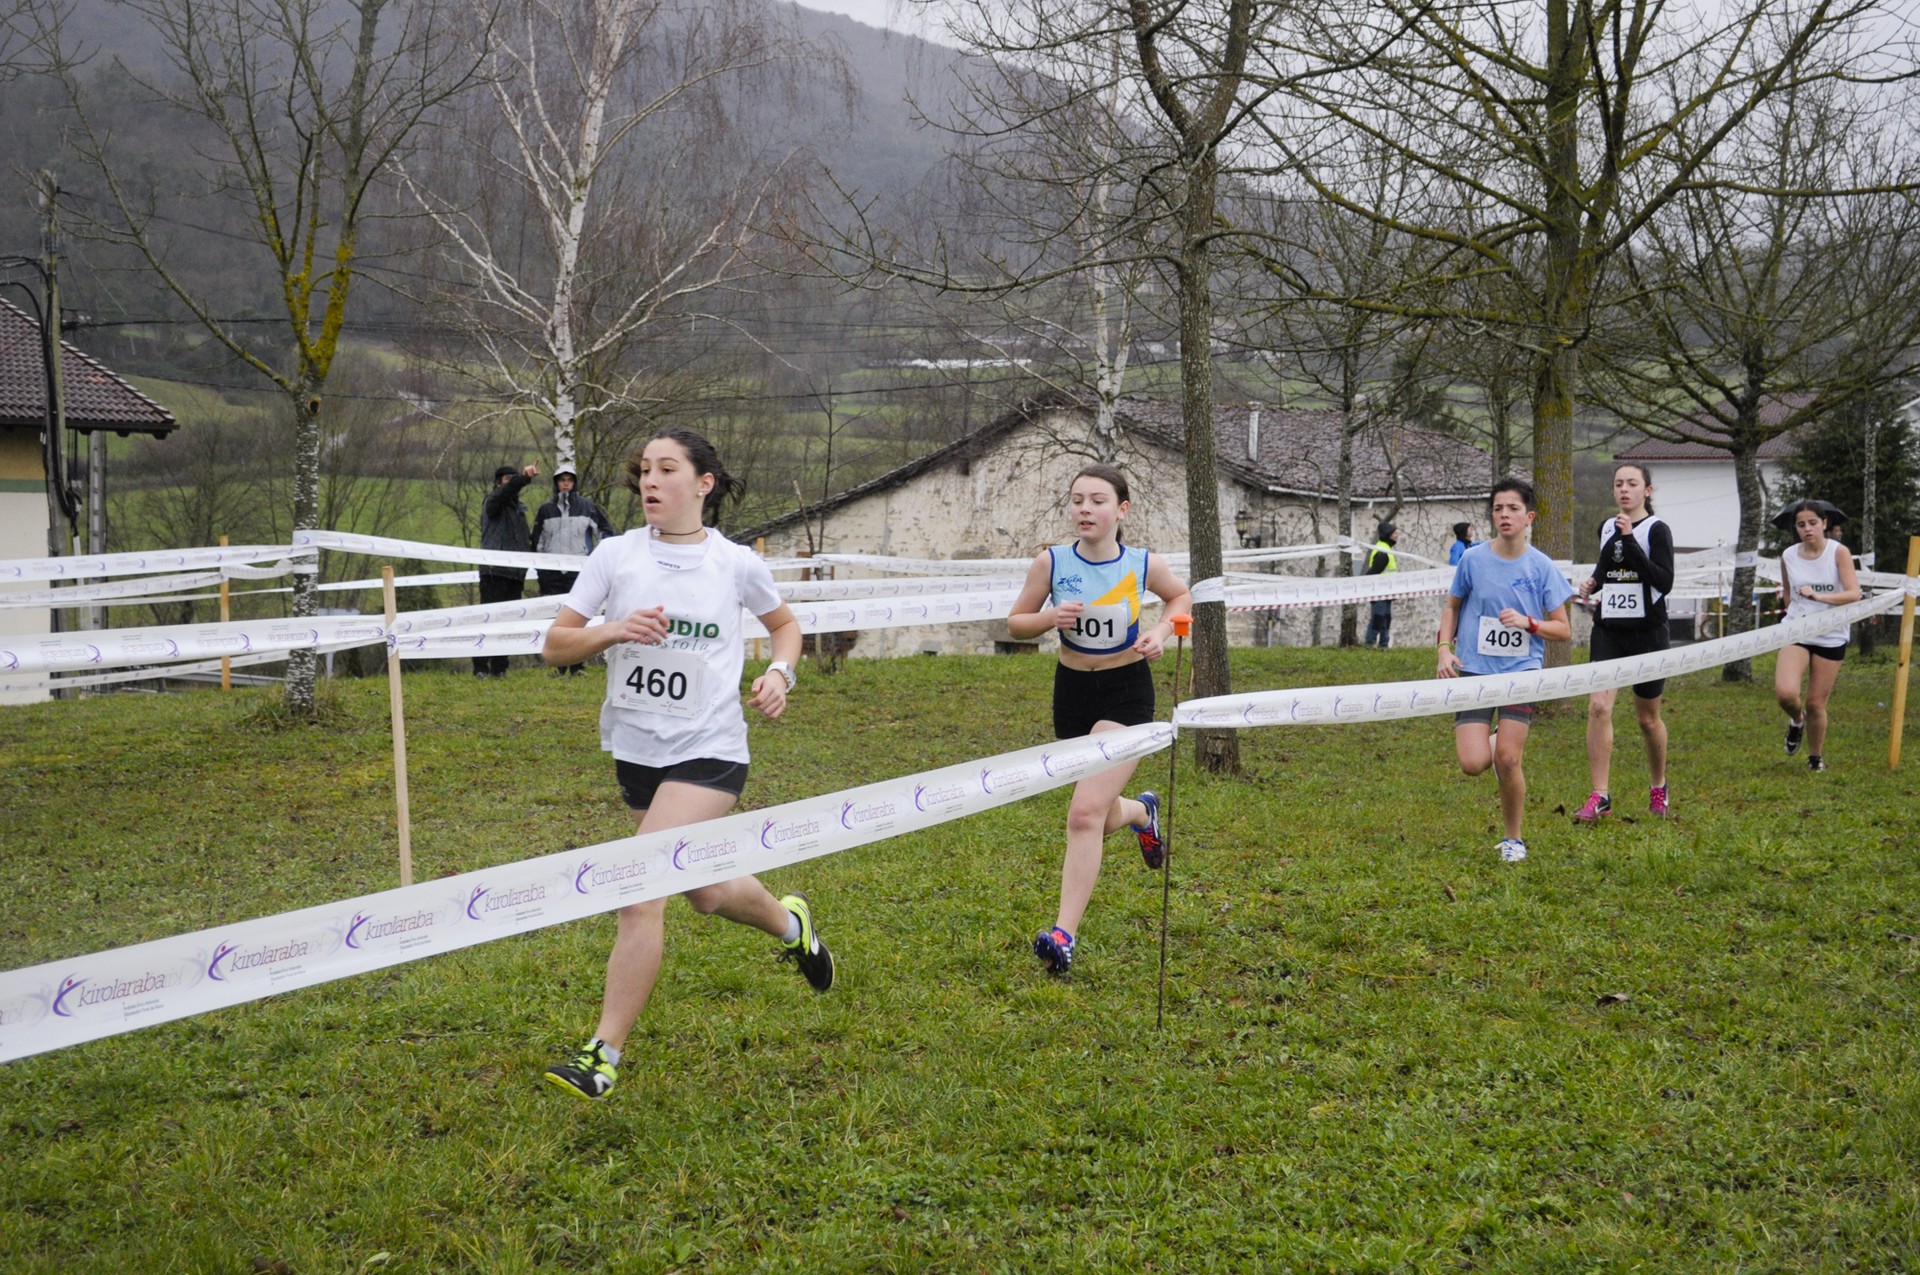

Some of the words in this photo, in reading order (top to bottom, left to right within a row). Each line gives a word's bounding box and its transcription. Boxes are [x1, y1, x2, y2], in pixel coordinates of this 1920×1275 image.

[1607, 593, 1638, 610] 425
[1069, 617, 1114, 638] 401
[1485, 629, 1523, 648] 403
[625, 665, 688, 701] 460
[853, 800, 897, 824] kirolaraba
[774, 817, 820, 843] kirolaraba
[687, 837, 738, 864] kirolaraba
[591, 858, 647, 887] kirolaraba
[484, 883, 546, 913] kirolaraba
[364, 910, 434, 941] kirolaraba
[229, 939, 309, 973] kirolaraba
[77, 972, 166, 1008] kirolaraba
